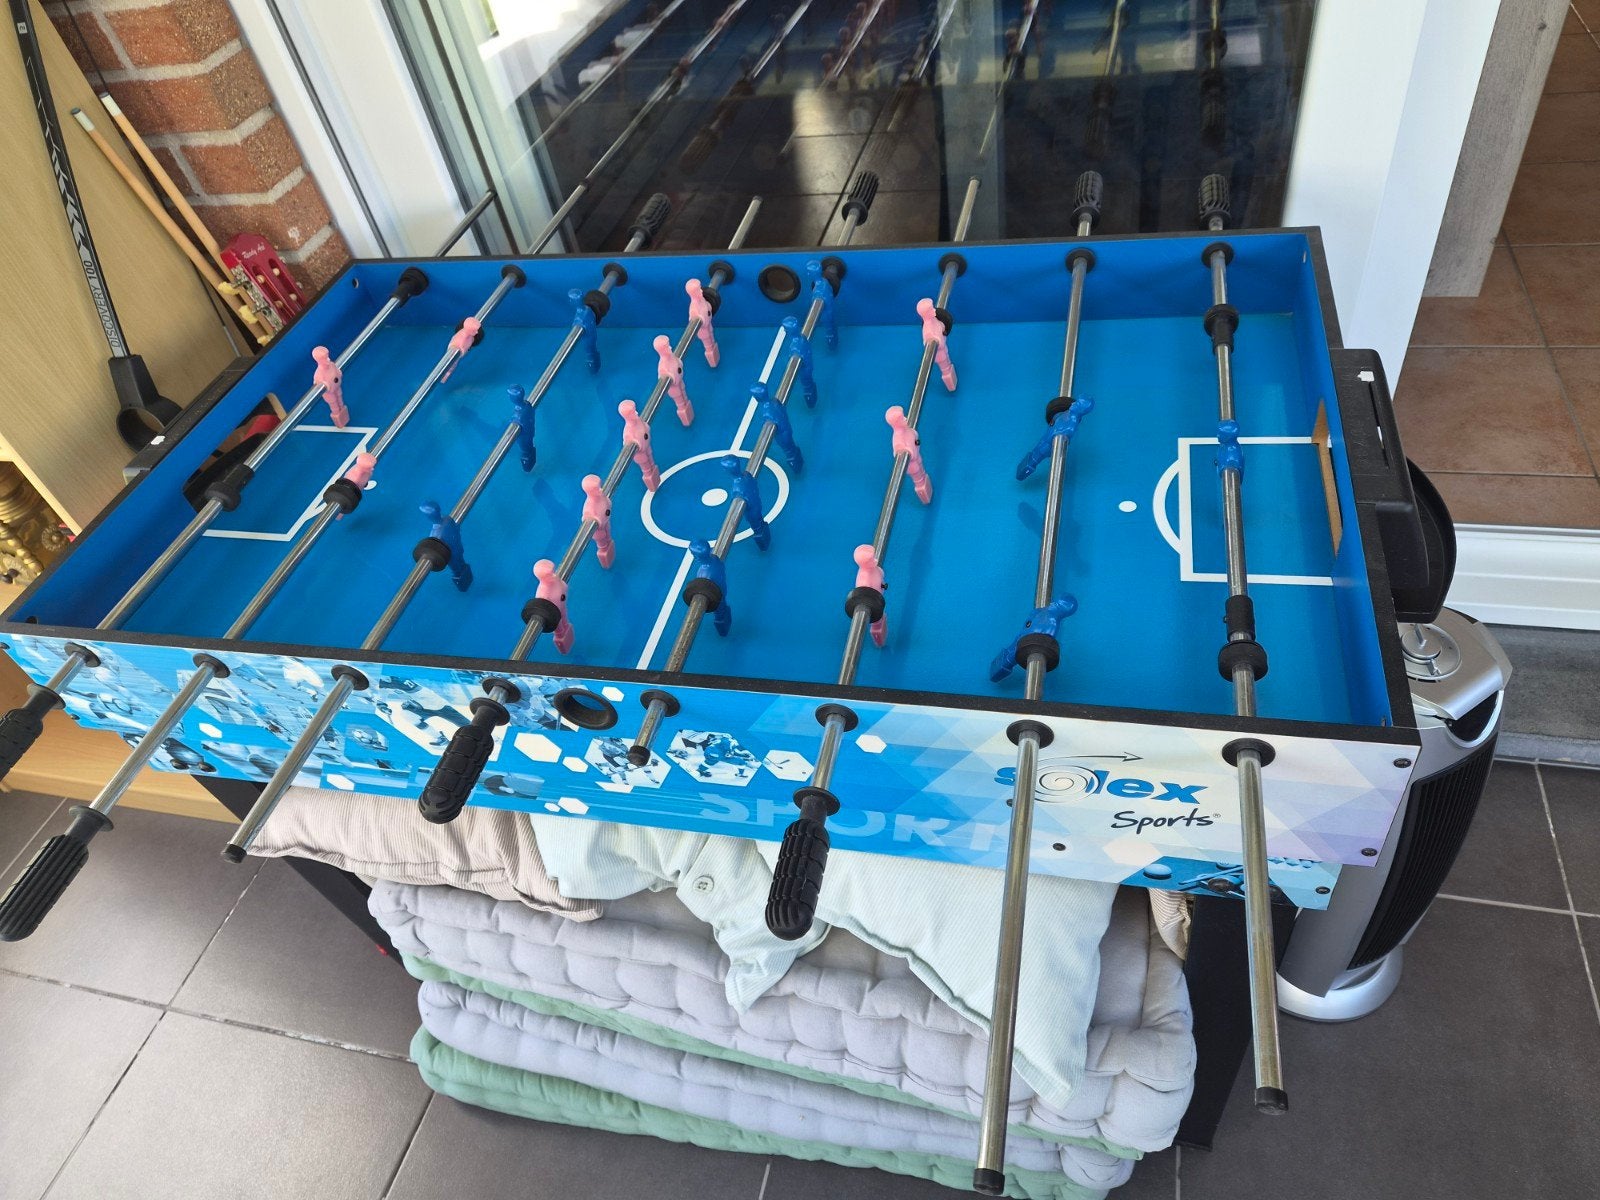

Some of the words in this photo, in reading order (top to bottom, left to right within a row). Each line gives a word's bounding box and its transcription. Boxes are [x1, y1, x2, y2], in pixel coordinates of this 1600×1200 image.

[83, 260, 97, 280] 100
[90, 285, 121, 348] DISCOVERY
[1110, 807, 1214, 835] Sports
